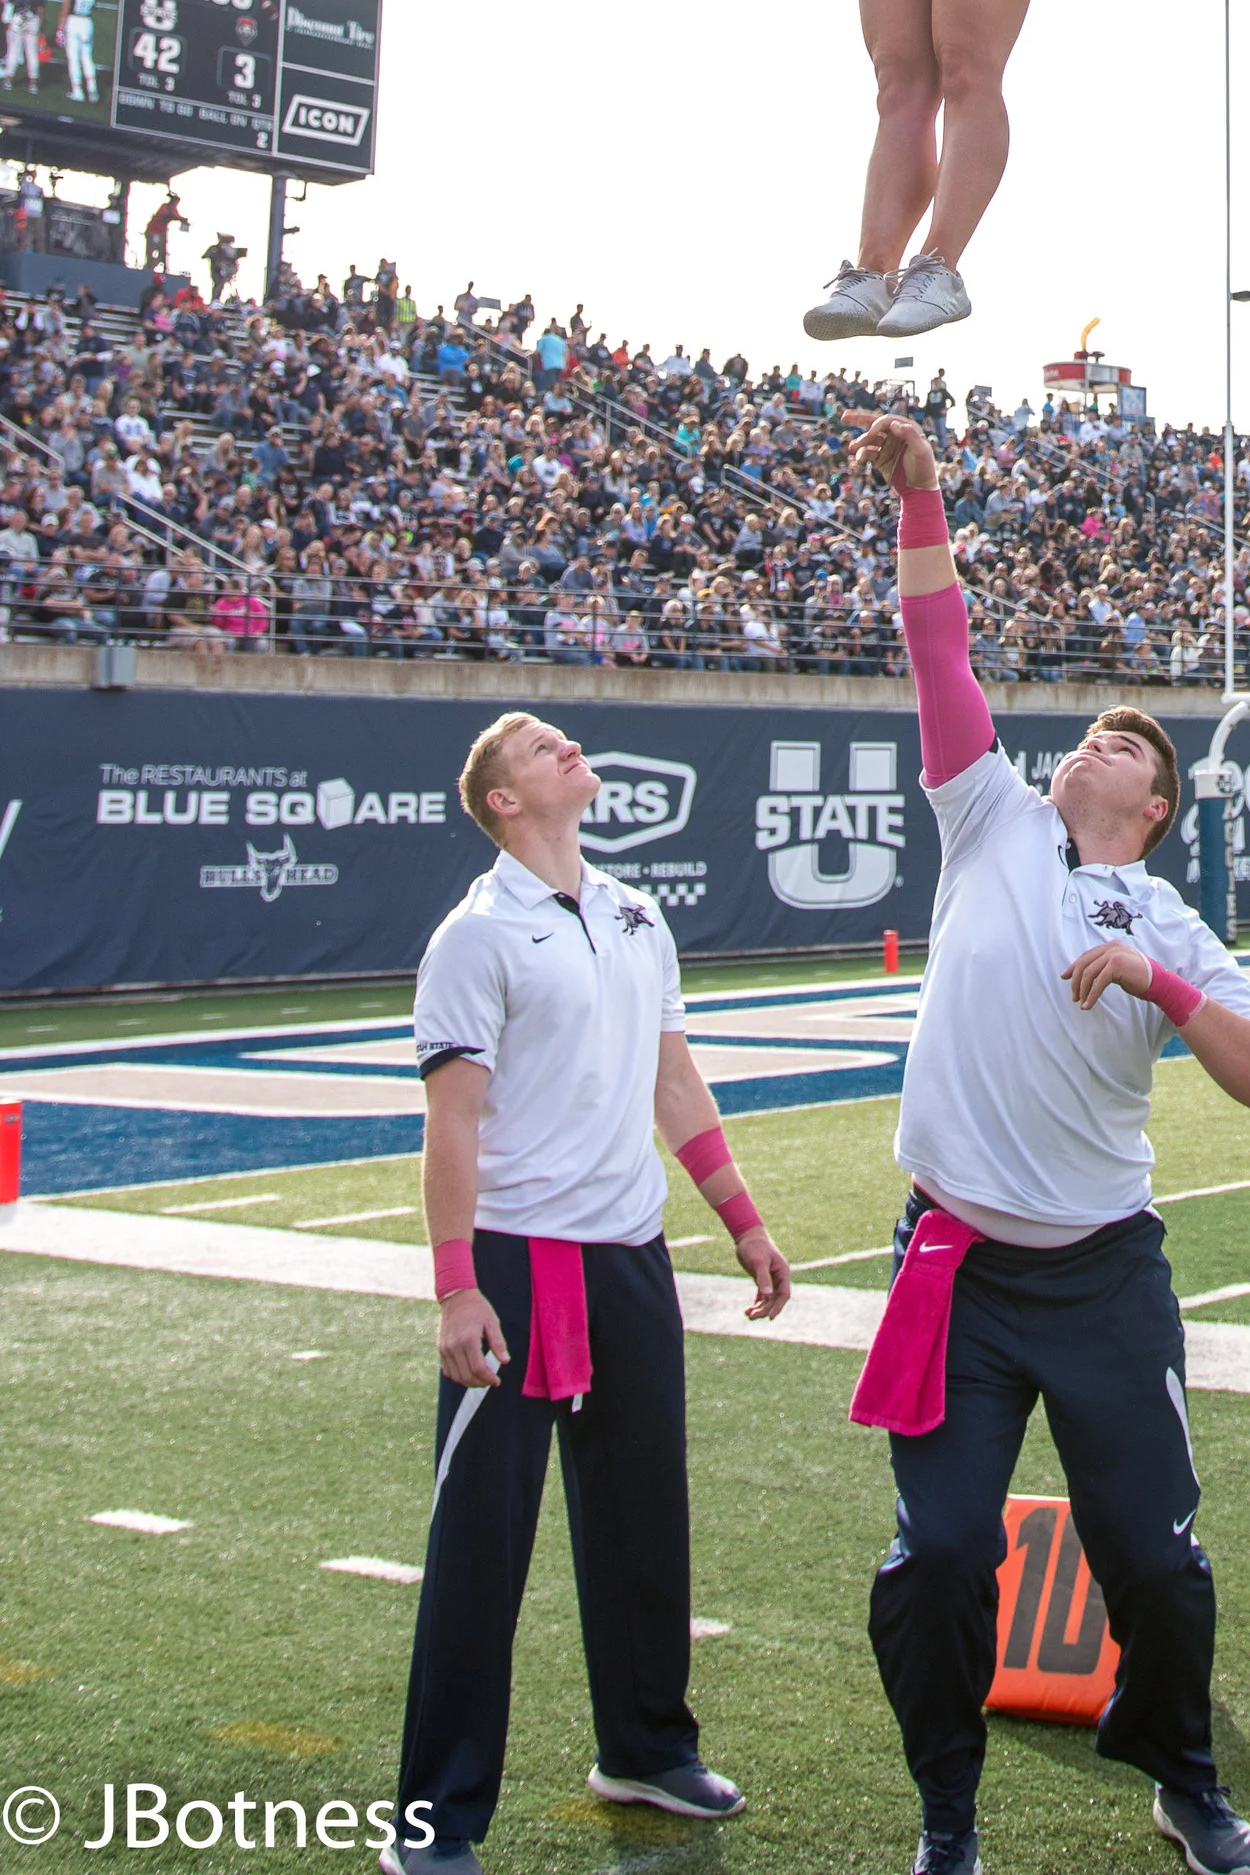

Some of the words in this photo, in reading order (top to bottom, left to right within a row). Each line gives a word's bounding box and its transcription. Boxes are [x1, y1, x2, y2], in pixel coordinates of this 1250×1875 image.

[133, 32, 181, 74] 42
[164, 76, 175, 92] 3
[233, 53, 256, 89] 3
[251, 93, 262, 109] 3
[299, 108, 354, 134] ICON
[256, 131, 268, 148] 2
[100, 763, 138, 785] The
[140, 764, 287, 787] RESTAURANTS
[288, 769, 308, 787] at
[97, 789, 230, 825] BLUE
[755, 793, 906, 850] STATE
[650, 861, 707, 879] REBUILD
[1002, 1507, 1110, 1675] 10
